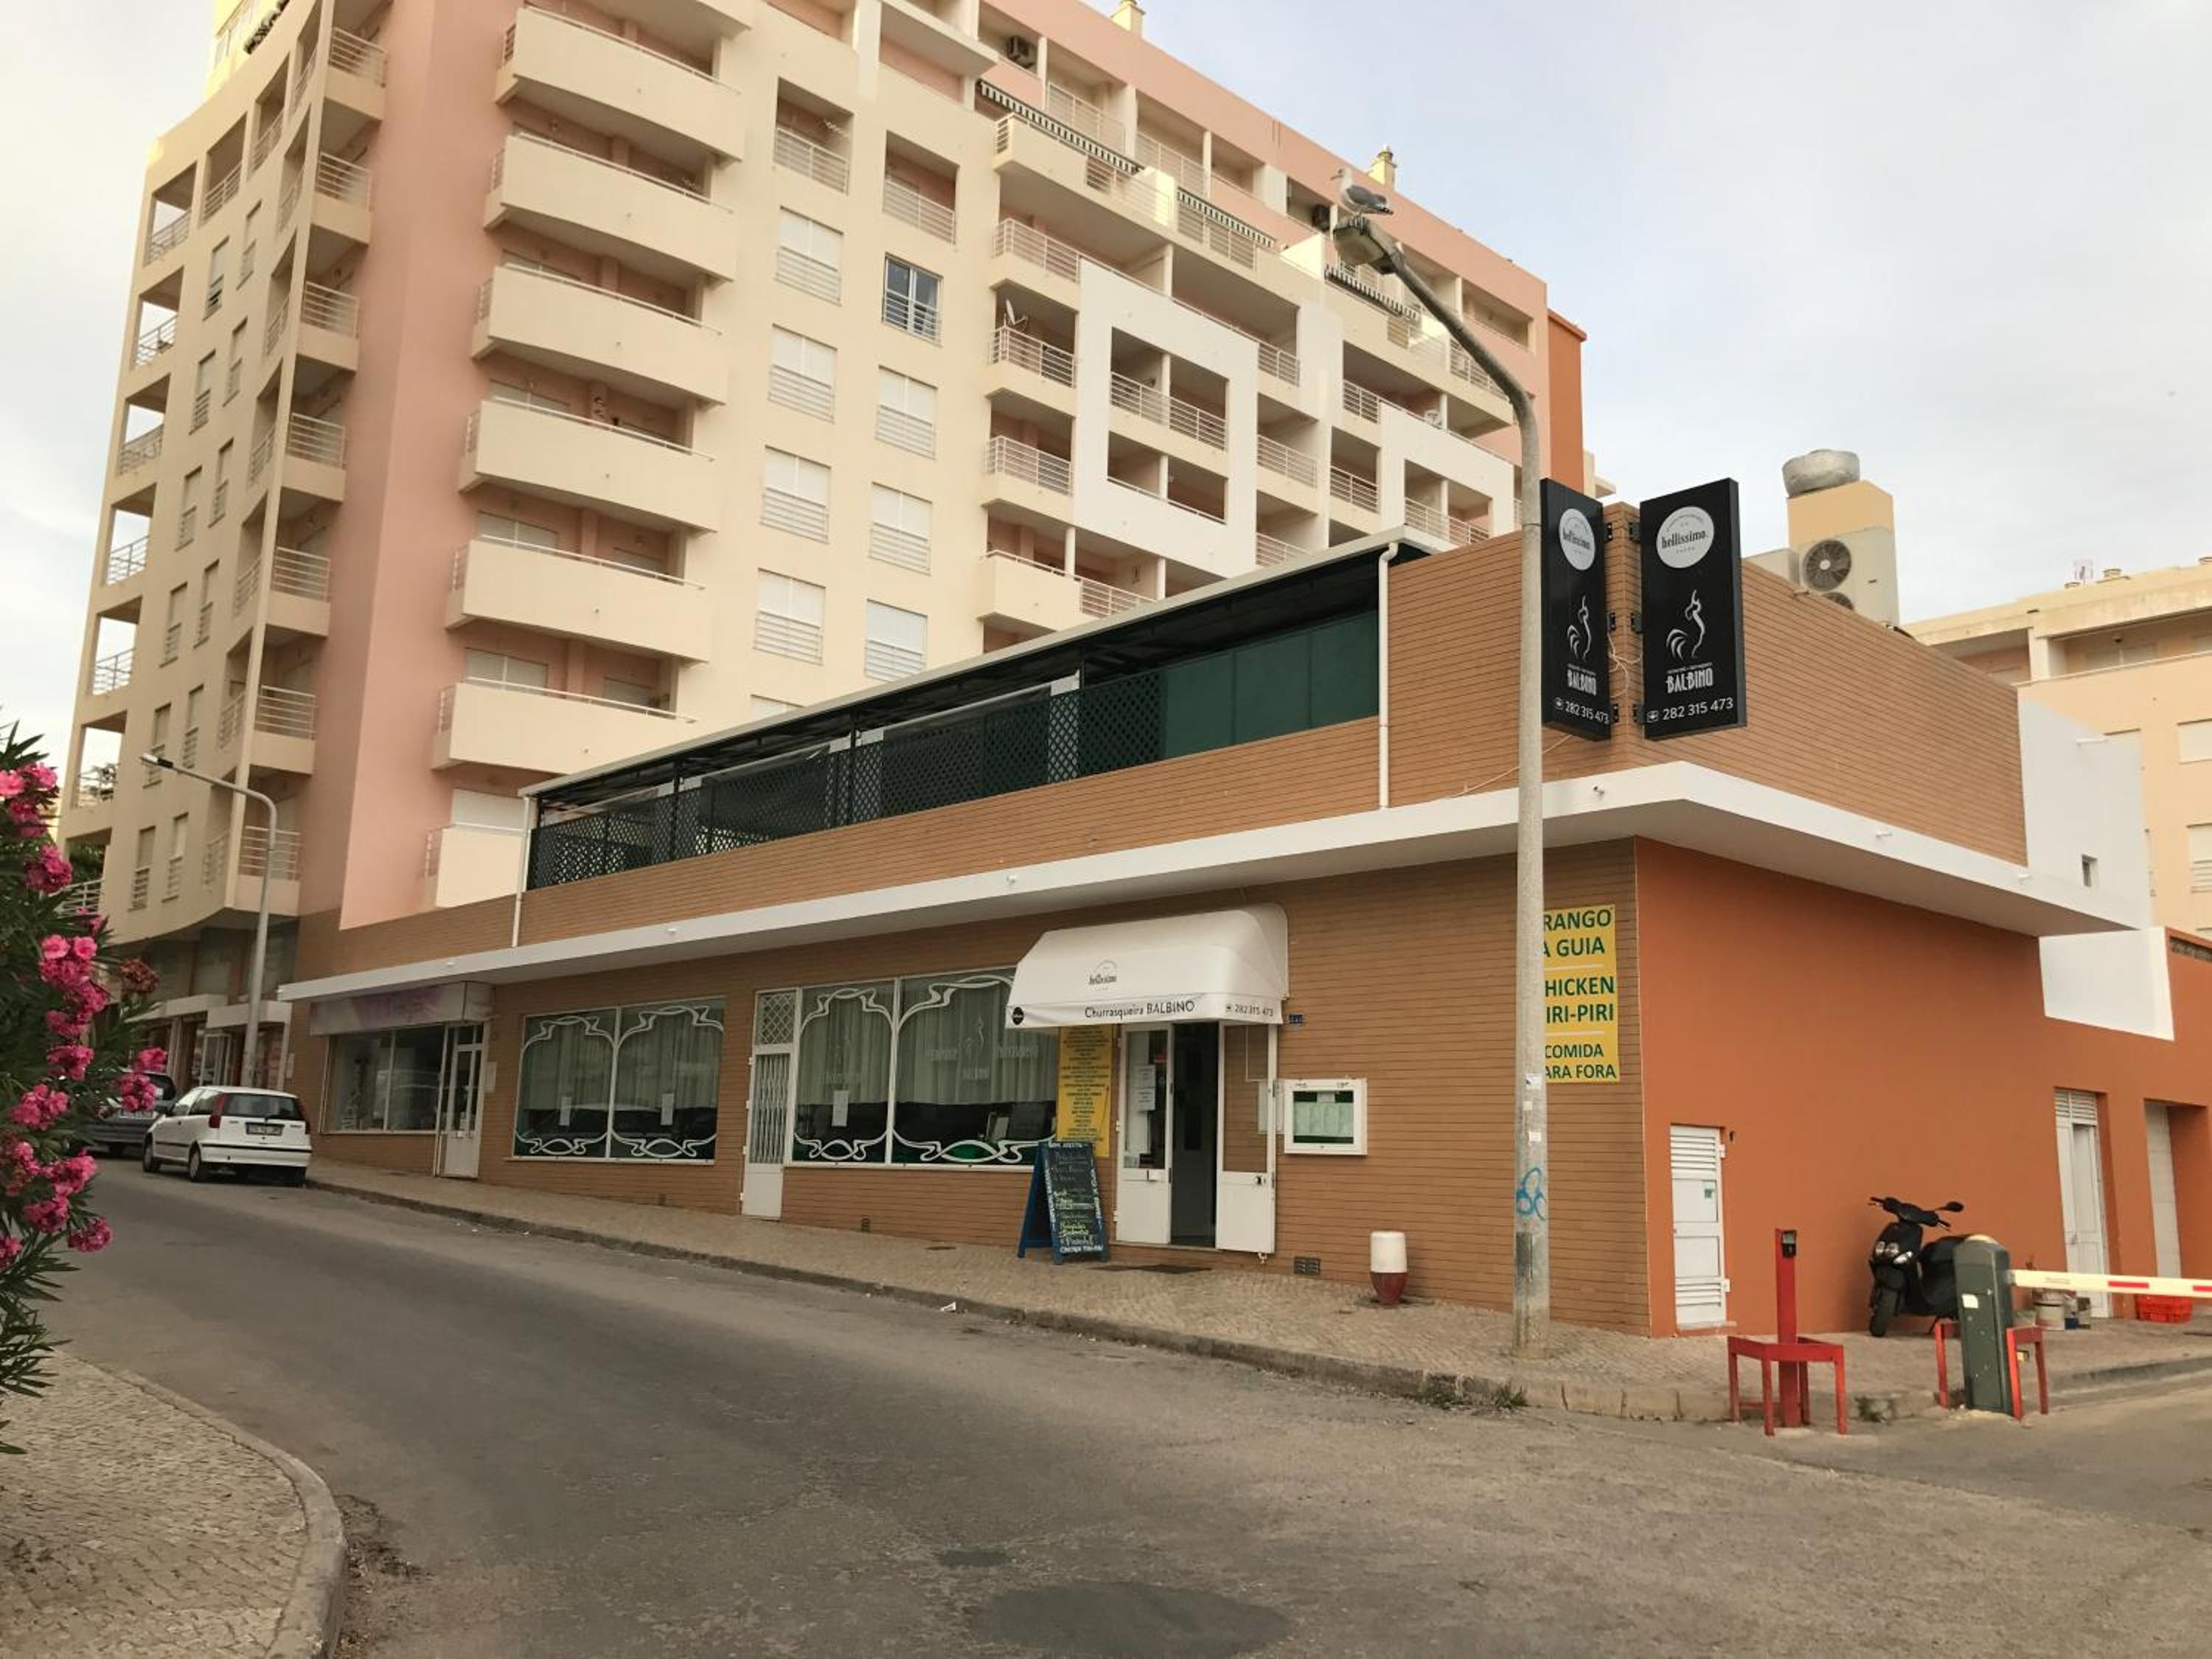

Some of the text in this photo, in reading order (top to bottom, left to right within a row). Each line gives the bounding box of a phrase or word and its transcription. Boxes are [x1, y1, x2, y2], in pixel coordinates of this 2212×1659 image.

[1666, 667, 1713, 694] BALBINO
[1565, 700, 1610, 725] 282 315 473
[1663, 697, 1733, 720] 282 315 473
[1544, 909, 1612, 931] RANGO
[1557, 936, 1605, 957] GUIA
[1545, 975, 1615, 997] HICKEN
[1085, 1000, 1195, 1020] Churrasqueira BALBINO
[1546, 1004, 1614, 1023] IRI-PIRI
[1545, 1043, 1604, 1059] COMIDA
[1545, 1063, 1617, 1079] ARA FORA
